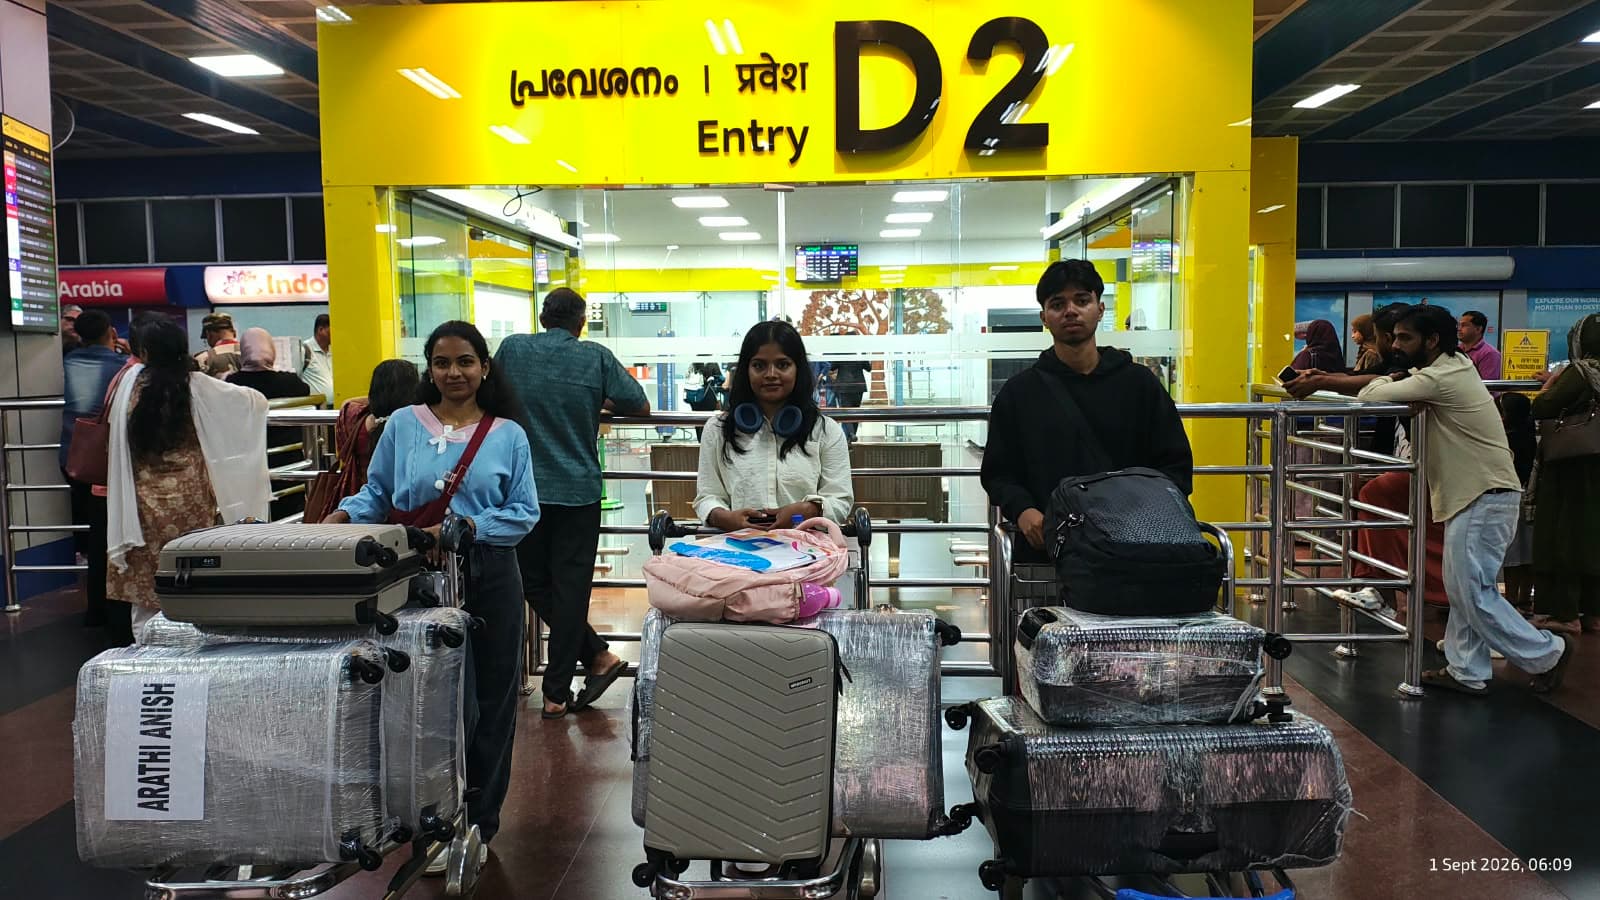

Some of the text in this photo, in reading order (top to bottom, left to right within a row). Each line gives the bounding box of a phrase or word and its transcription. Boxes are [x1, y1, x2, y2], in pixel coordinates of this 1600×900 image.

[510, 66, 679, 106] പ്രവേശനം
[736, 52, 809, 93] प्रवेश
[834, 16, 1050, 155] D2
[698, 119, 809, 164] Entry
[59, 279, 124, 298] Arabia
[266, 272, 328, 295] Indo
[137, 683, 176, 812] ARATHI ANISH
